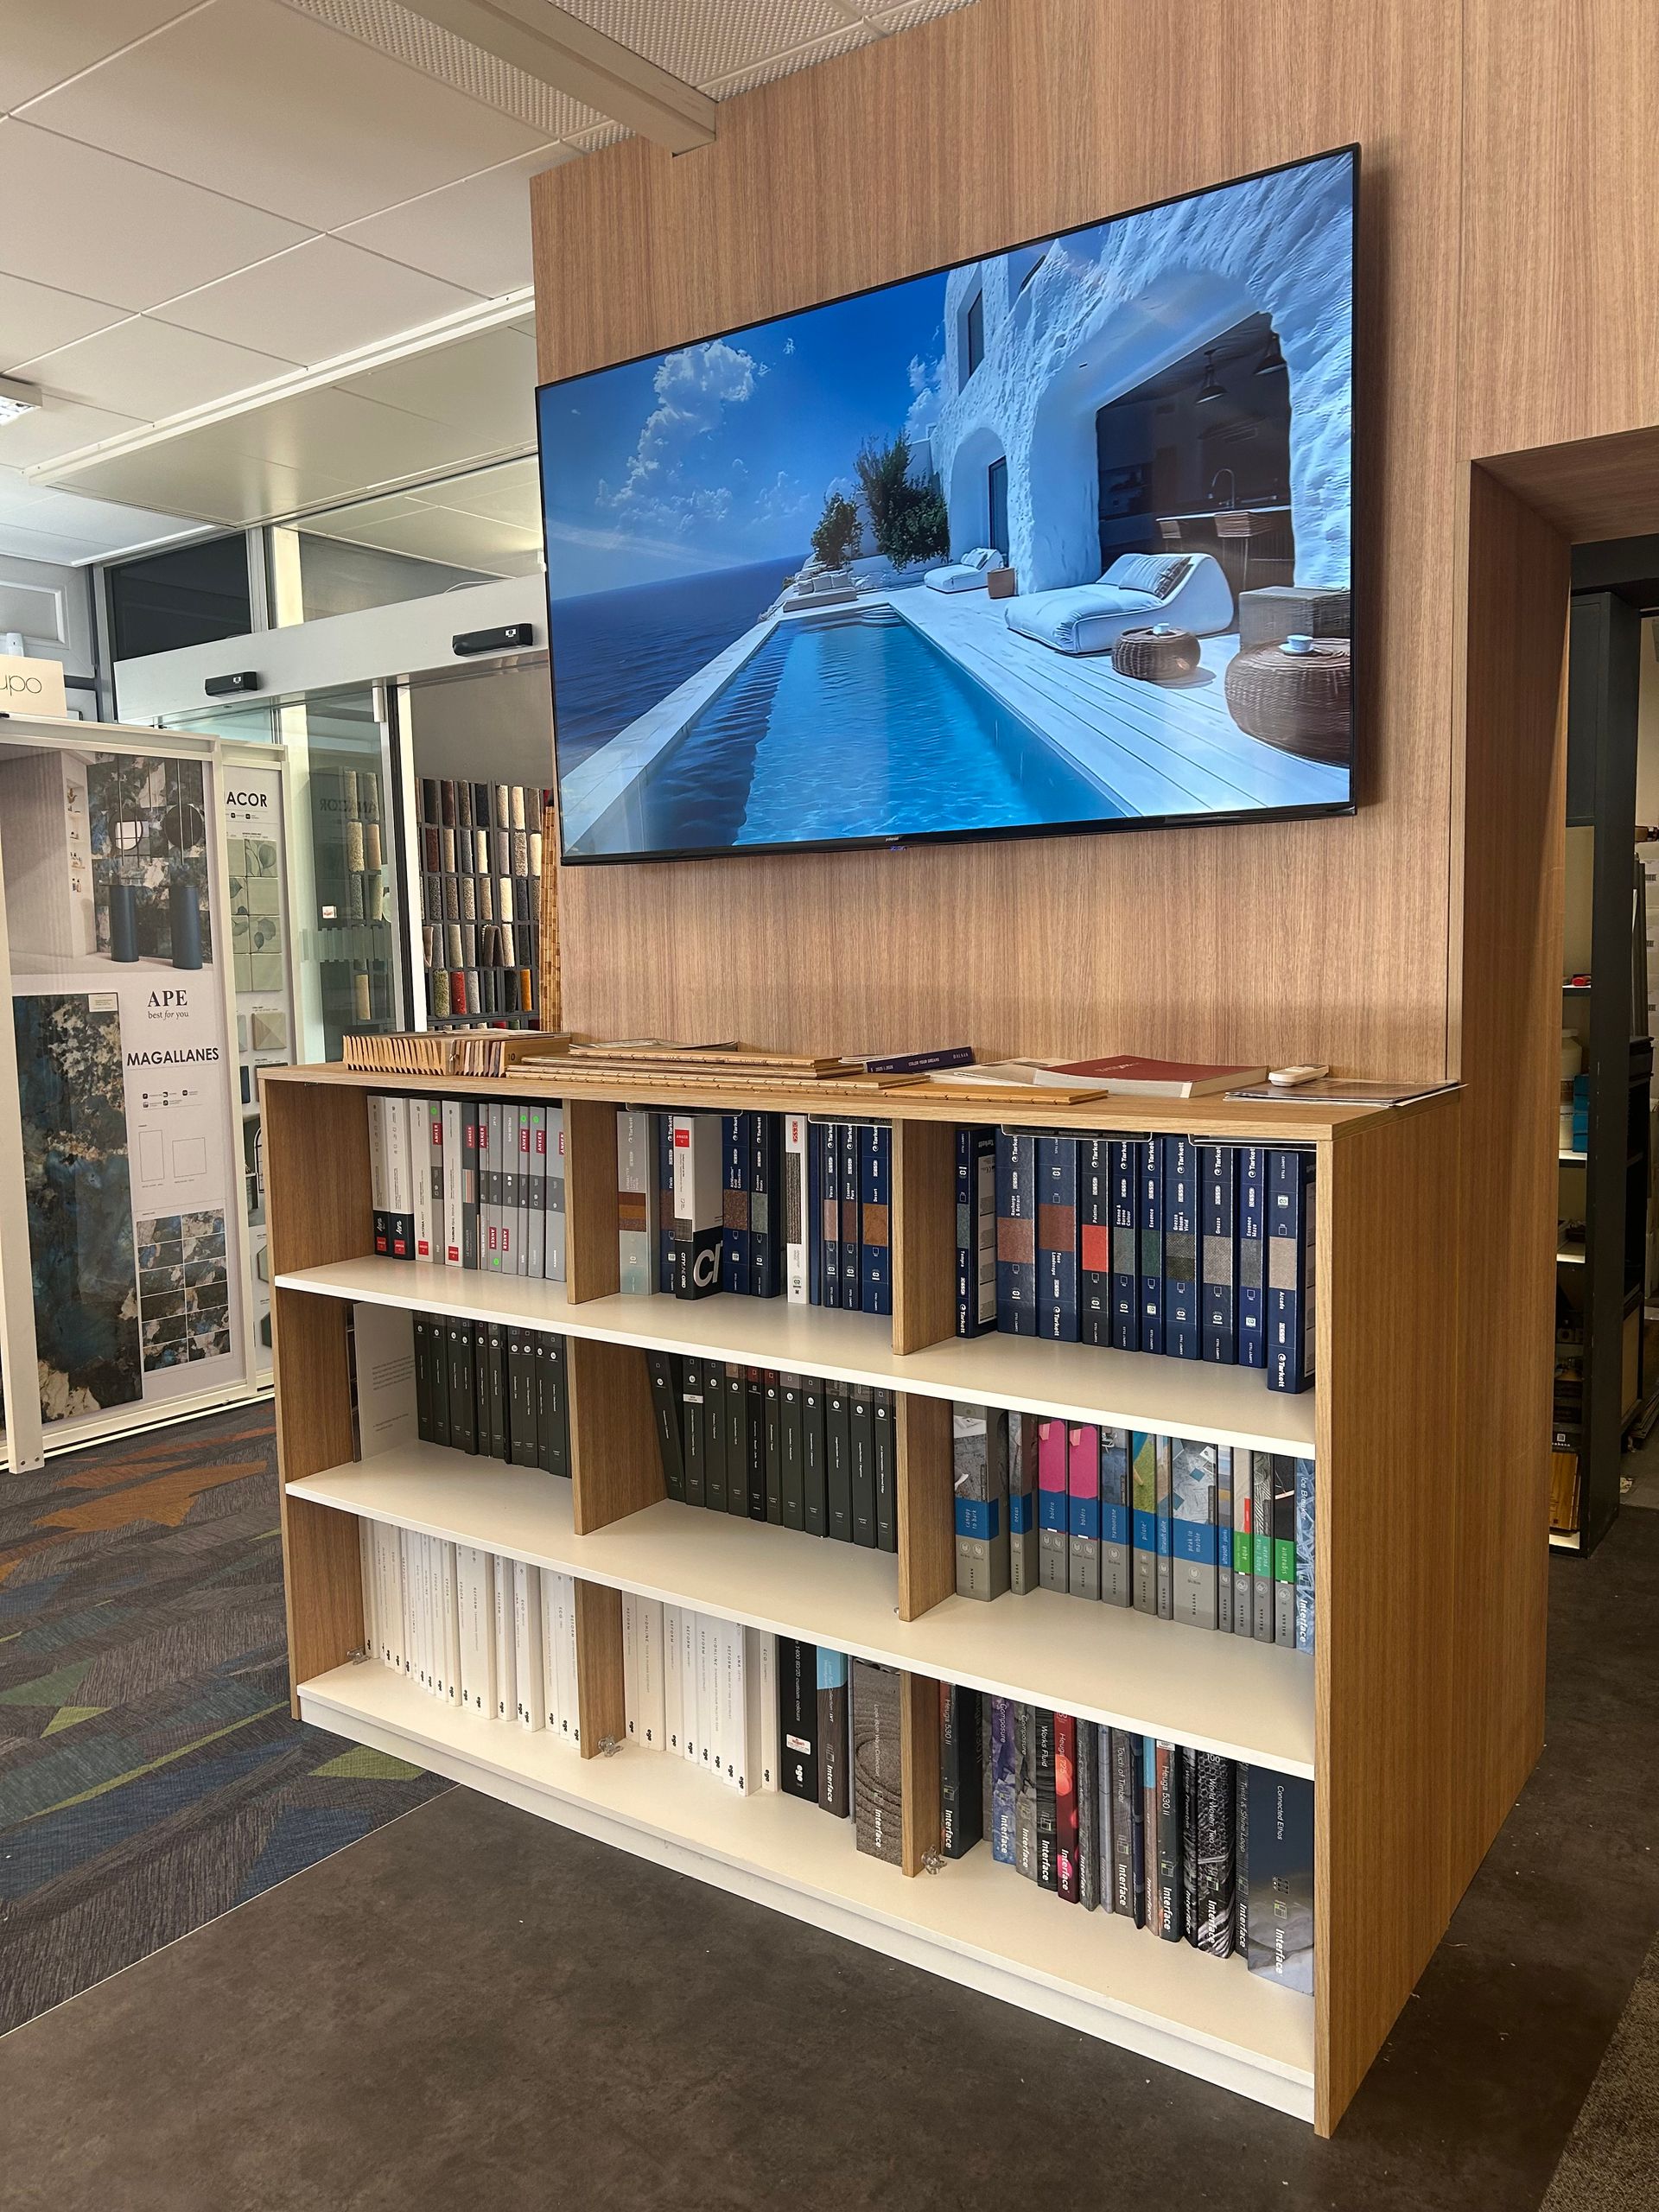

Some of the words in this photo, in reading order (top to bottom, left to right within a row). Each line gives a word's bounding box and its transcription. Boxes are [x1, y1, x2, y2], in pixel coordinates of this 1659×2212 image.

[147, 990, 188, 1007] APE
[148, 1011, 163, 1019] best
[163, 1011, 175, 1021] for
[176, 1011, 189, 1020] you
[127, 1048, 219, 1066] MAGALLANES
[507, 1053, 516, 1062] 10
[1300, 1599, 1308, 1643] Interface
[1207, 1754, 1220, 1762] 100
[1118, 1769, 1124, 1777] of
[1160, 1765, 1169, 1791] Heuga
[1209, 1802, 1217, 1827] Woven
[1041, 1840, 1049, 1882] Interface
[1119, 1864, 1127, 1906] Interface
[1163, 1887, 1172, 1930] Interface
[1208, 1900, 1217, 1944] Interface
[1239, 1903, 1247, 1948] Interface
[1275, 1928, 1285, 1974] Interface
